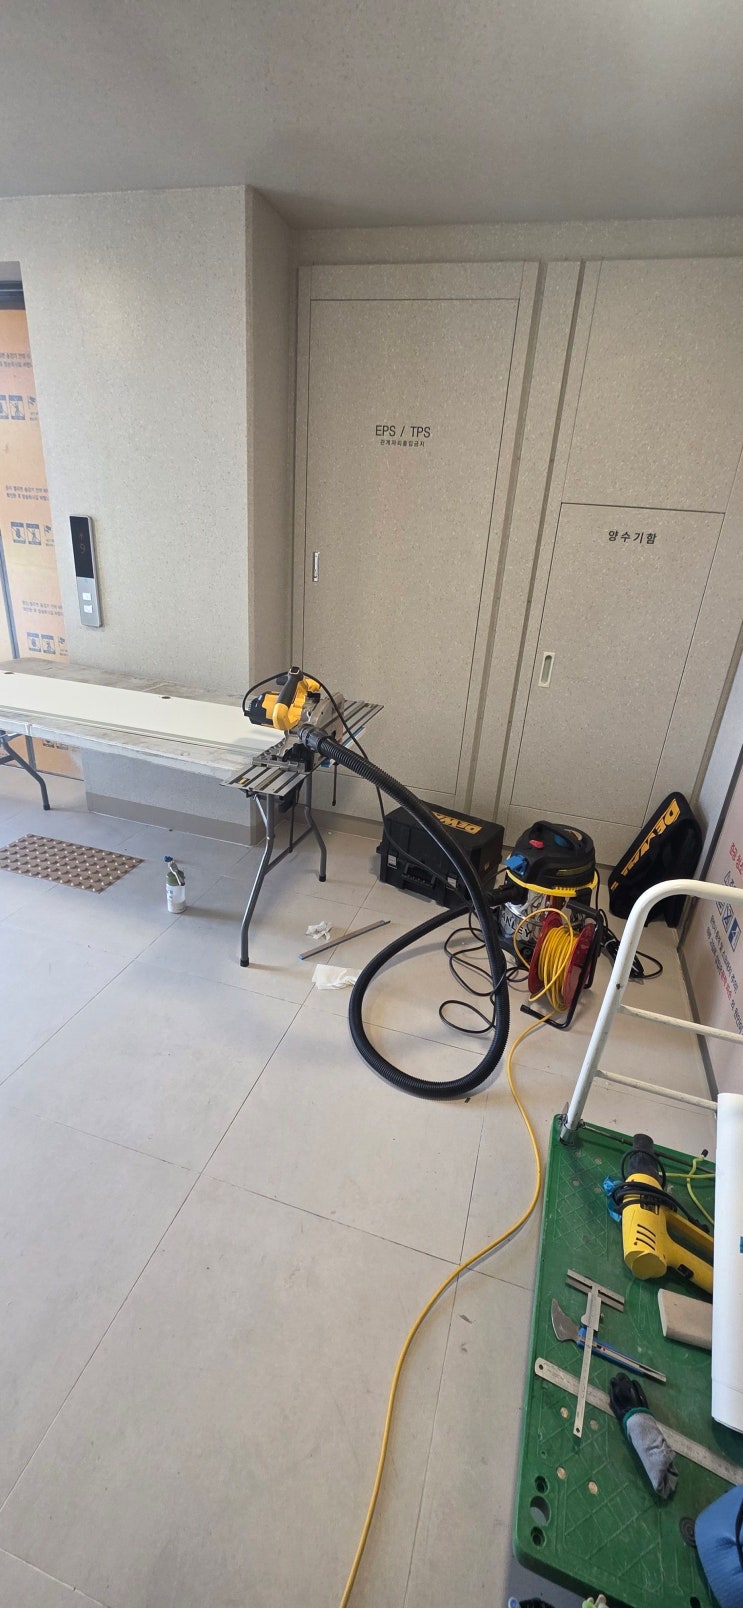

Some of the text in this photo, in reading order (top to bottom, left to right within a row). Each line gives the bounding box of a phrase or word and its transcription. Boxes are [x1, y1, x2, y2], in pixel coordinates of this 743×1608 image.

[375, 424, 431, 438] EPS / TPS
[608, 530, 657, 545] 양수기함
[431, 810, 483, 835] DEWA
